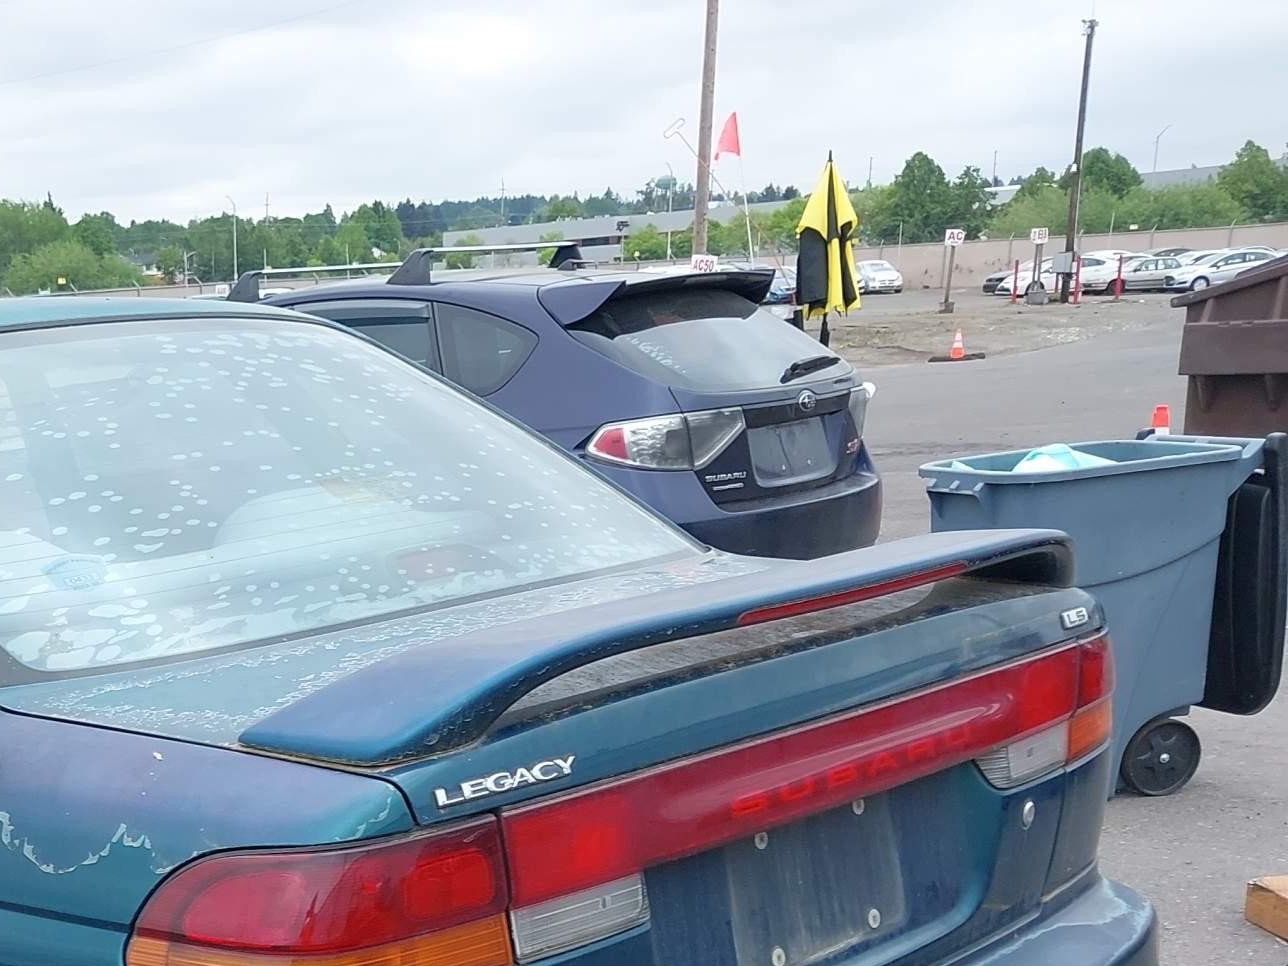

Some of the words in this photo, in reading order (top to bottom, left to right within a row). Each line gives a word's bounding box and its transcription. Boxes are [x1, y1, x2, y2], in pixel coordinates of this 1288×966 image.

[704, 471, 747, 483] SUBARU
[1065, 609, 1086, 625] LS
[433, 755, 576, 807] LEGACY
[731, 729, 970, 817] SUBARU
